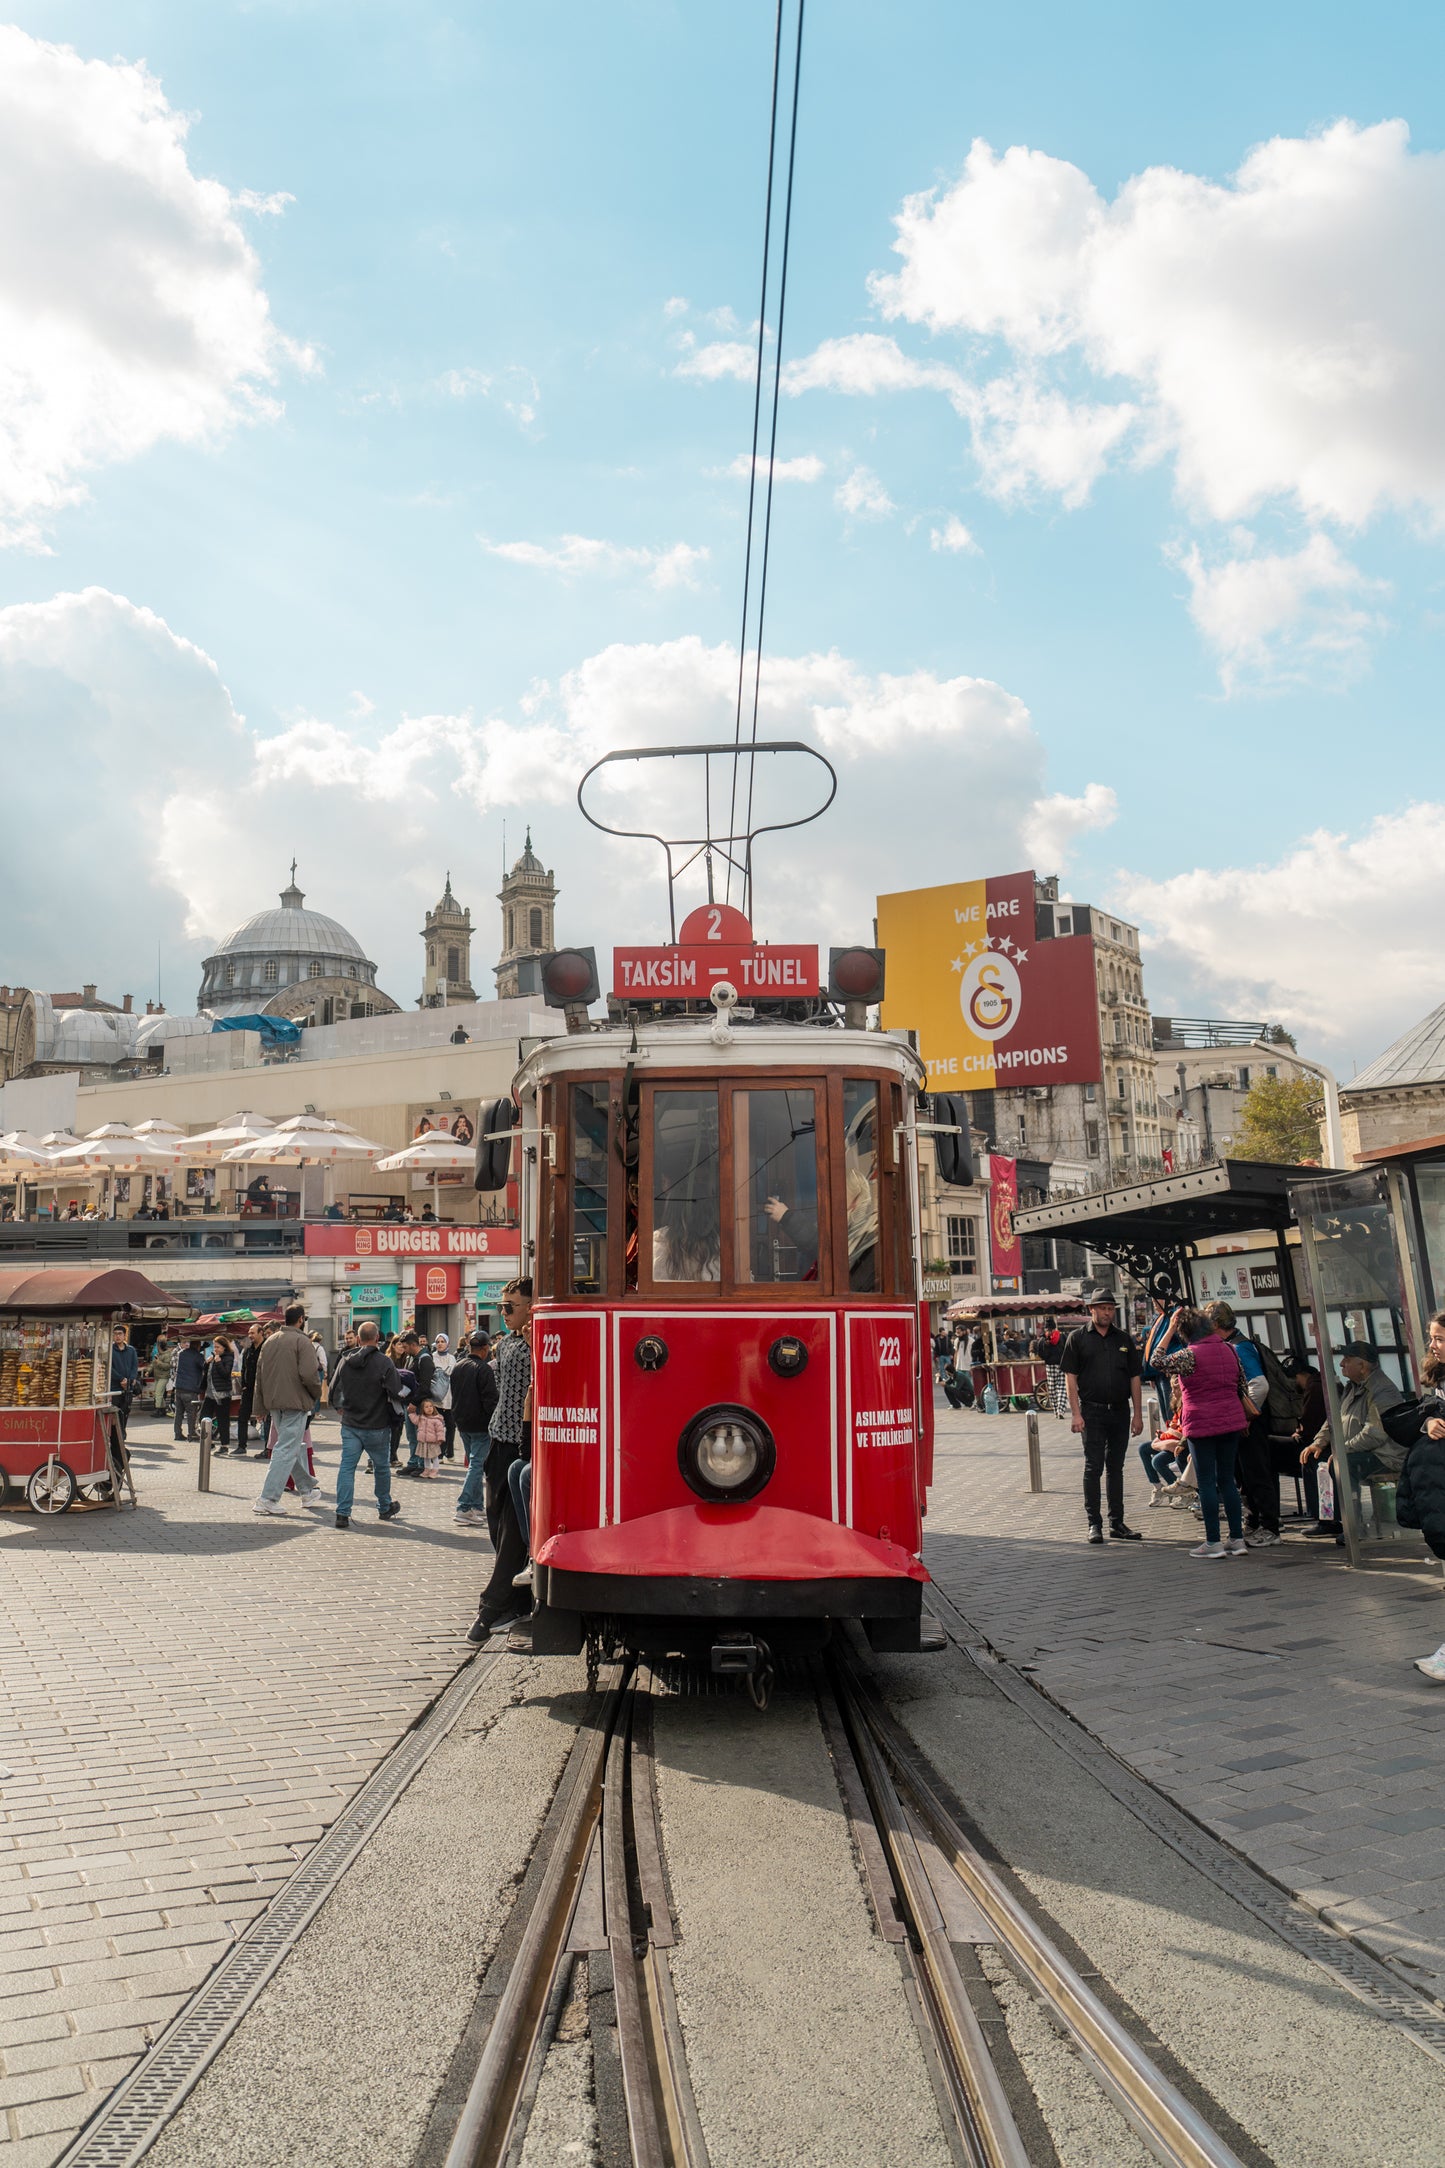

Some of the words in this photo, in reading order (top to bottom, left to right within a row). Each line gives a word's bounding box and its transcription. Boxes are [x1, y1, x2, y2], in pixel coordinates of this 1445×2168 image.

[954, 905, 980, 924] WE
[985, 899, 1020, 919] ARE
[707, 909, 722, 940] 2
[621, 953, 696, 987] TAKSİM
[740, 952, 807, 985] TÜNEL
[983, 1000, 998, 1008] 1905
[925, 1058, 958, 1076] THE
[963, 1046, 1068, 1072] CHAMPIONS
[377, 1230, 440, 1251] BURGER
[448, 1231, 488, 1252] KING
[428, 1284, 446, 1293] KING
[542, 1333, 561, 1363] 223
[879, 1337, 900, 1366] 223
[566, 1407, 598, 1423] YASAK
[855, 1410, 895, 1427] ASILMAK
[543, 1425, 597, 1444] TEHLİKELİDİR
[856, 1432, 869, 1448] VE
